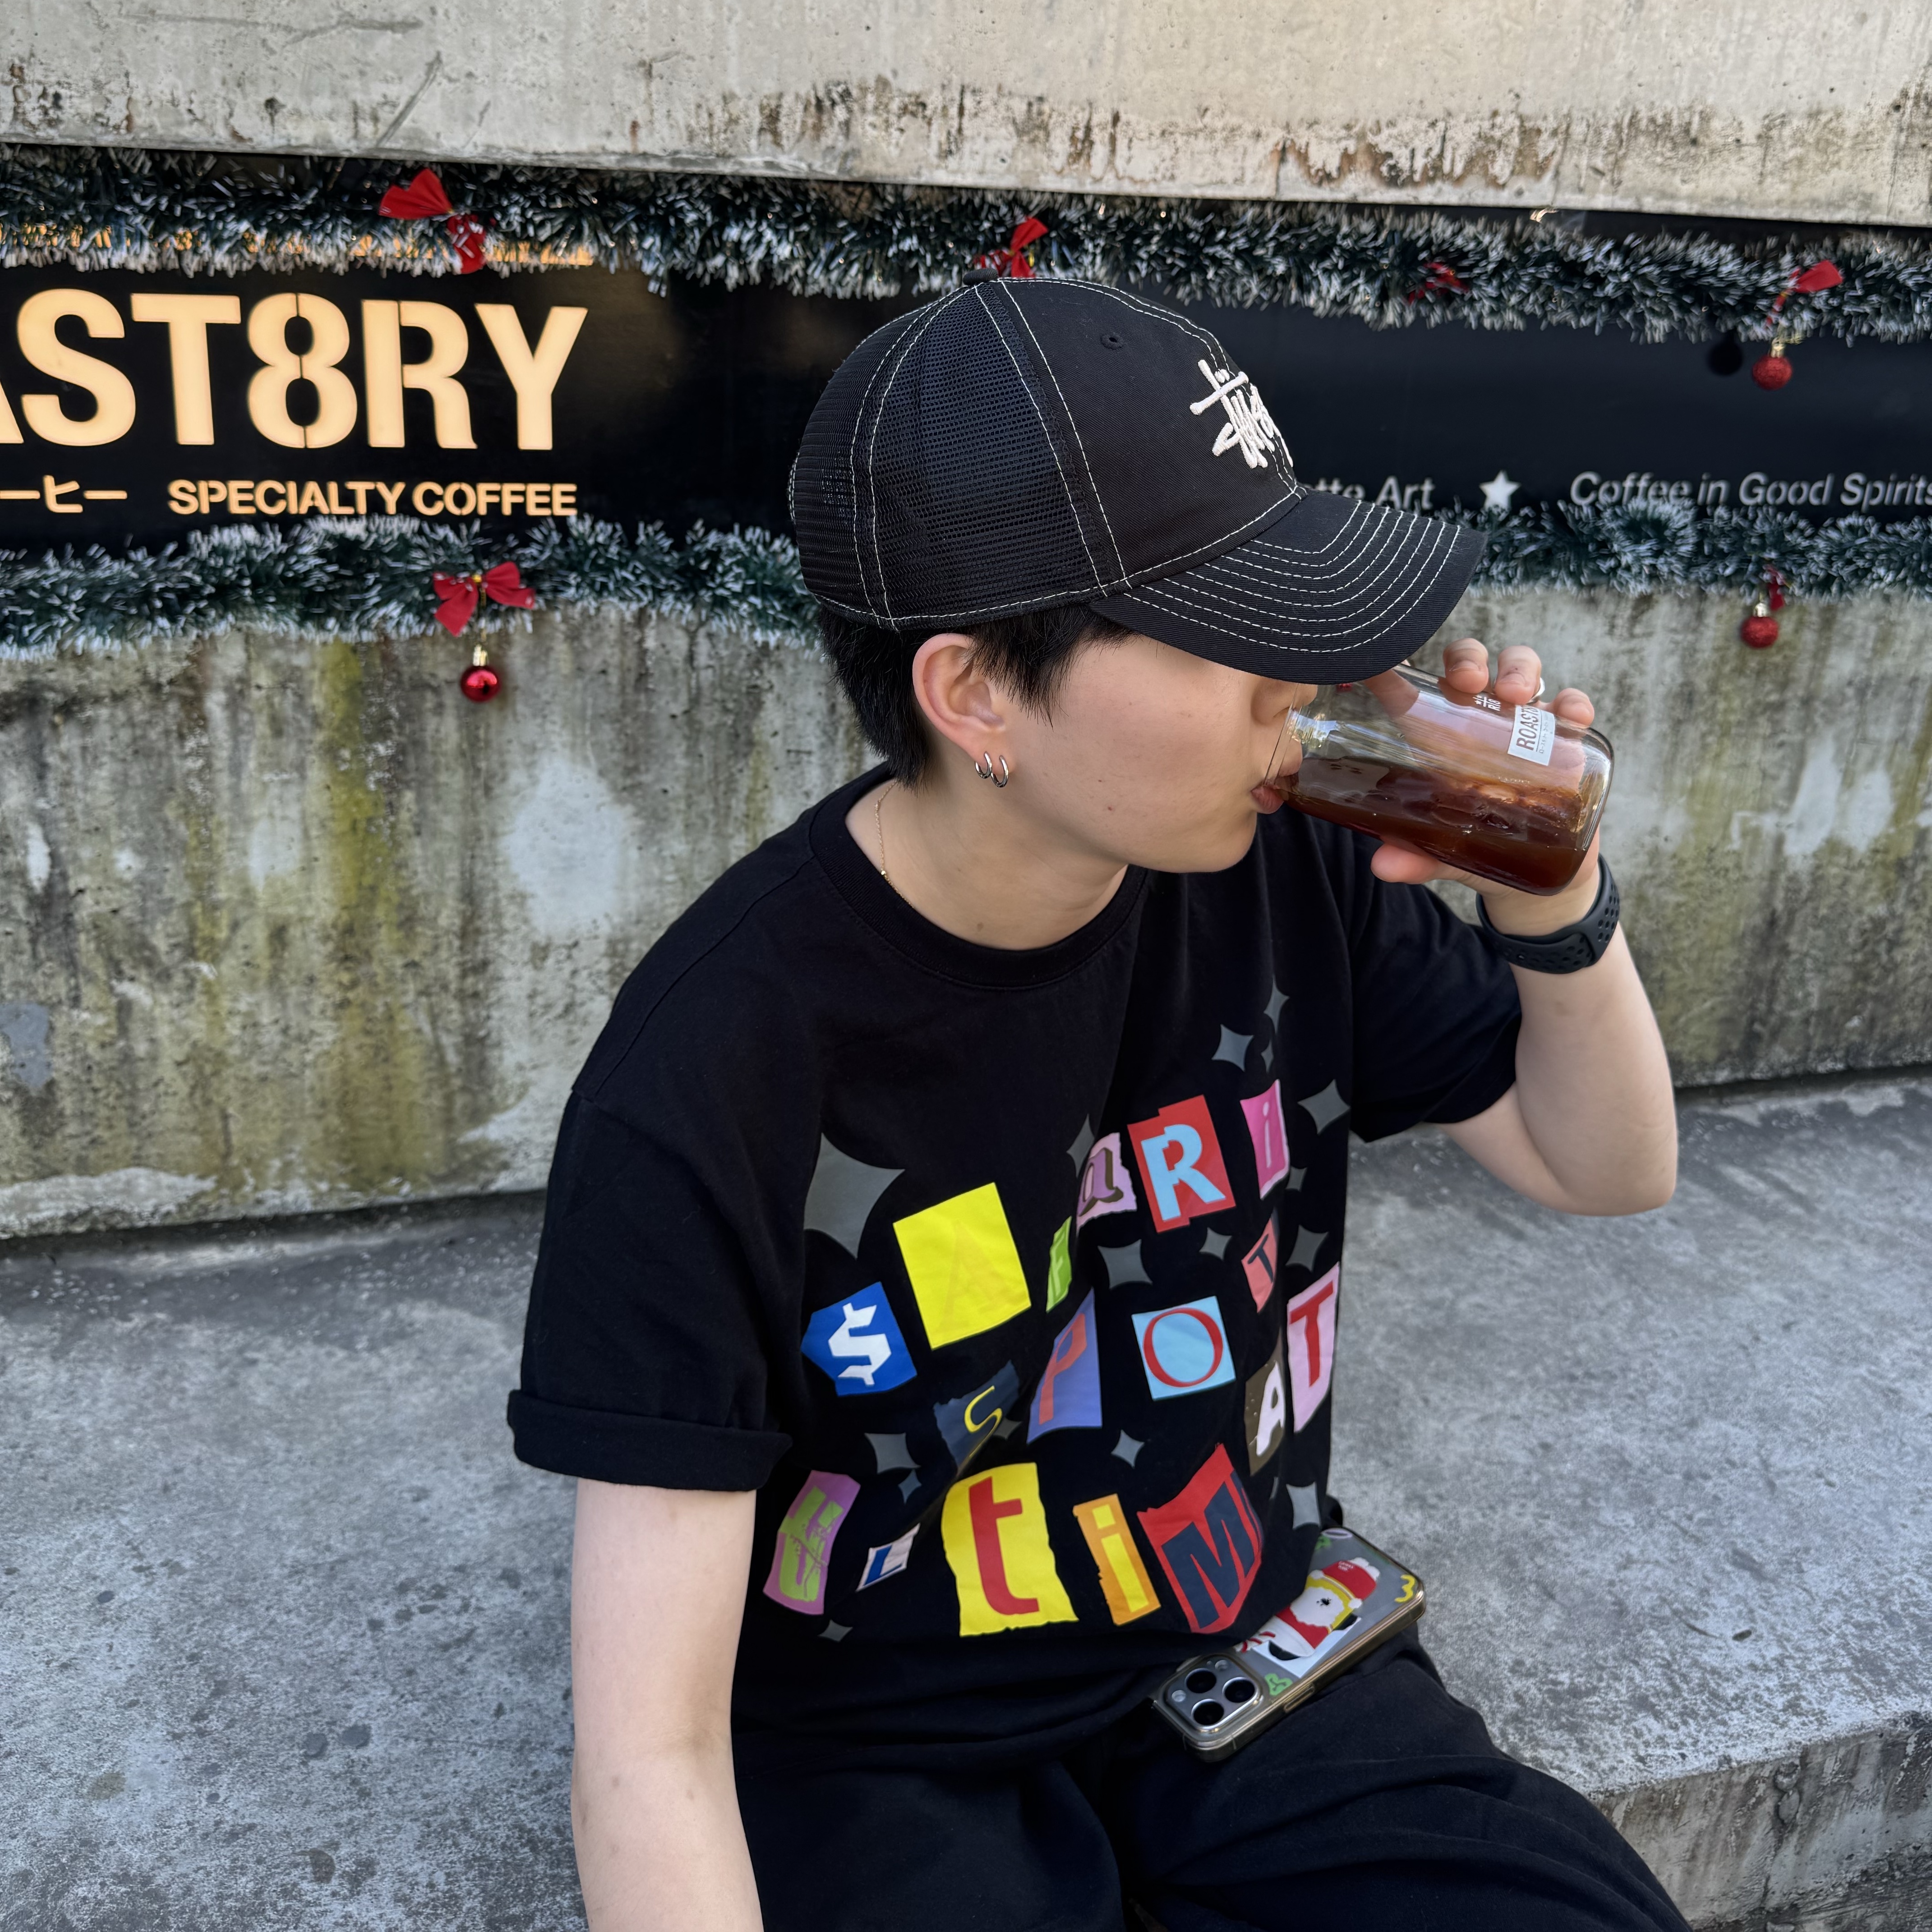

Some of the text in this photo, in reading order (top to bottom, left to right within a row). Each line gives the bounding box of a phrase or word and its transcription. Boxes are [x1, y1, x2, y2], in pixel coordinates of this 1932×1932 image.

[0, 289, 588, 450] ST8RY
[168, 479, 577, 516] SPECIALTY COFFEE
[1376, 475, 1435, 510] Art
[1570, 471, 1692, 506] Coffee
[1697, 472, 1730, 506] in
[1739, 471, 1835, 506] Good
